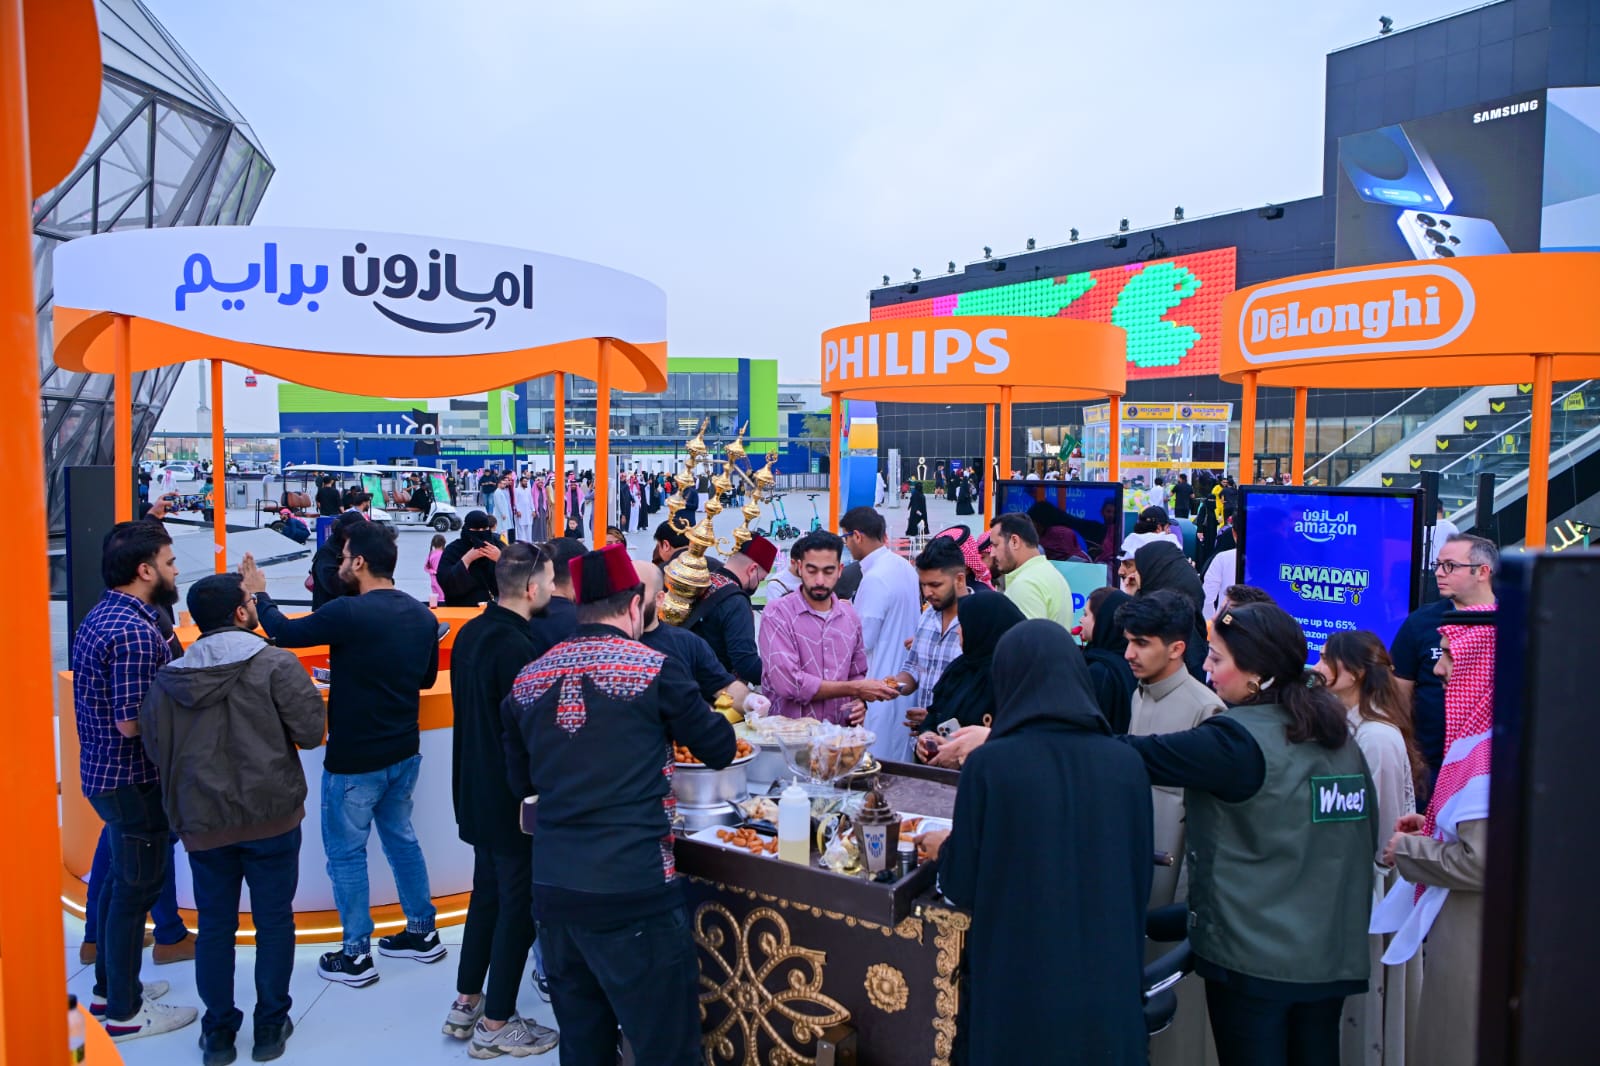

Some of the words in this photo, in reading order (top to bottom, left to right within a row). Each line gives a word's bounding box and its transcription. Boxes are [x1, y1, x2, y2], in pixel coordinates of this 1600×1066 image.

[1472, 99, 1539, 124] SAMSUNG
[175, 242, 329, 312] برايم
[824, 327, 1010, 383] PHILIPS
[1294, 521, 1357, 536] amazon
[1281, 565, 1368, 587] RAMADAN
[1300, 583, 1345, 602] SALE
[1310, 618, 1323, 628] up
[1323, 618, 1334, 628] to
[1335, 620, 1357, 631] 65%
[1303, 630, 1328, 640] azon
